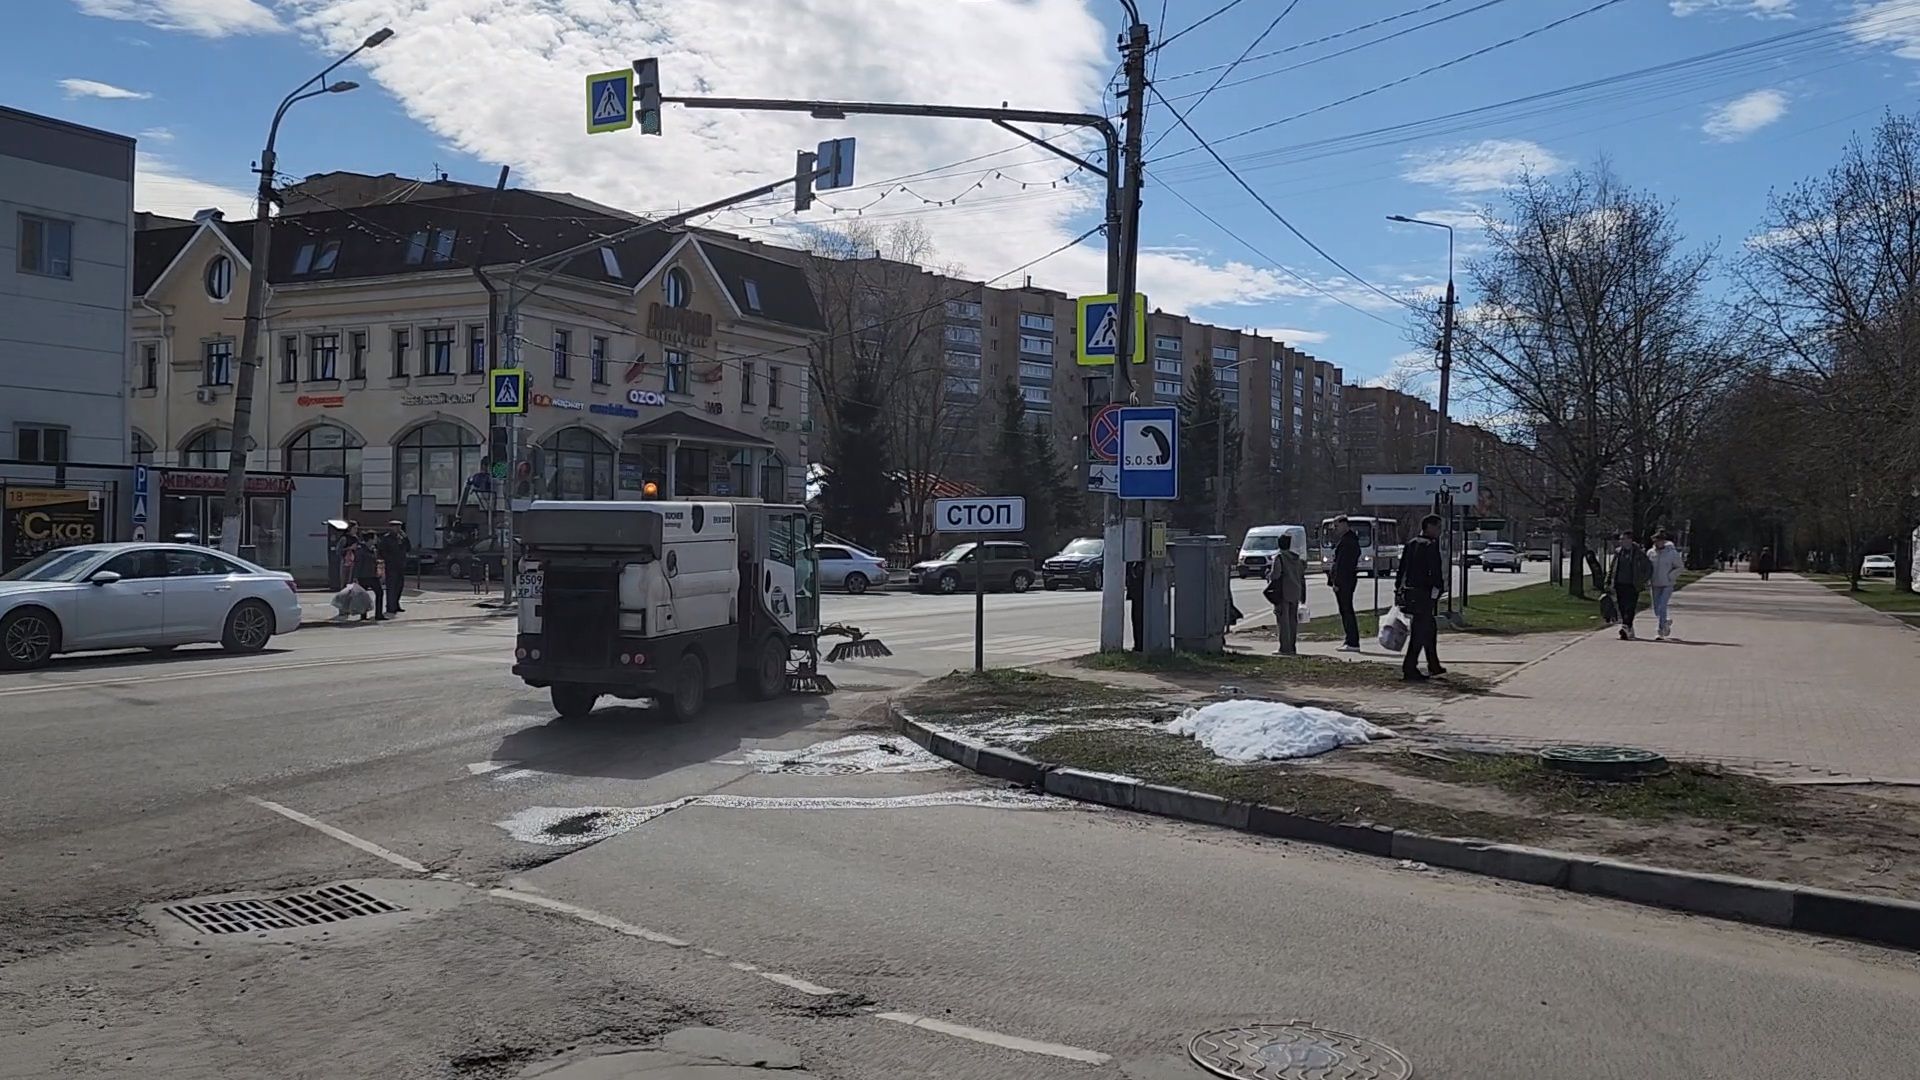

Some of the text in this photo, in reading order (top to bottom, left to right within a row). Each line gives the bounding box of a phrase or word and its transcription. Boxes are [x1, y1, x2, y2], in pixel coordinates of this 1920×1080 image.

[630, 390, 665, 406] OZON
[1125, 455, 1157, 466] S.O.S.
[10, 491, 24, 502] 18
[947, 504, 1012, 526] СТОП
[24, 511, 96, 540] Сказ
